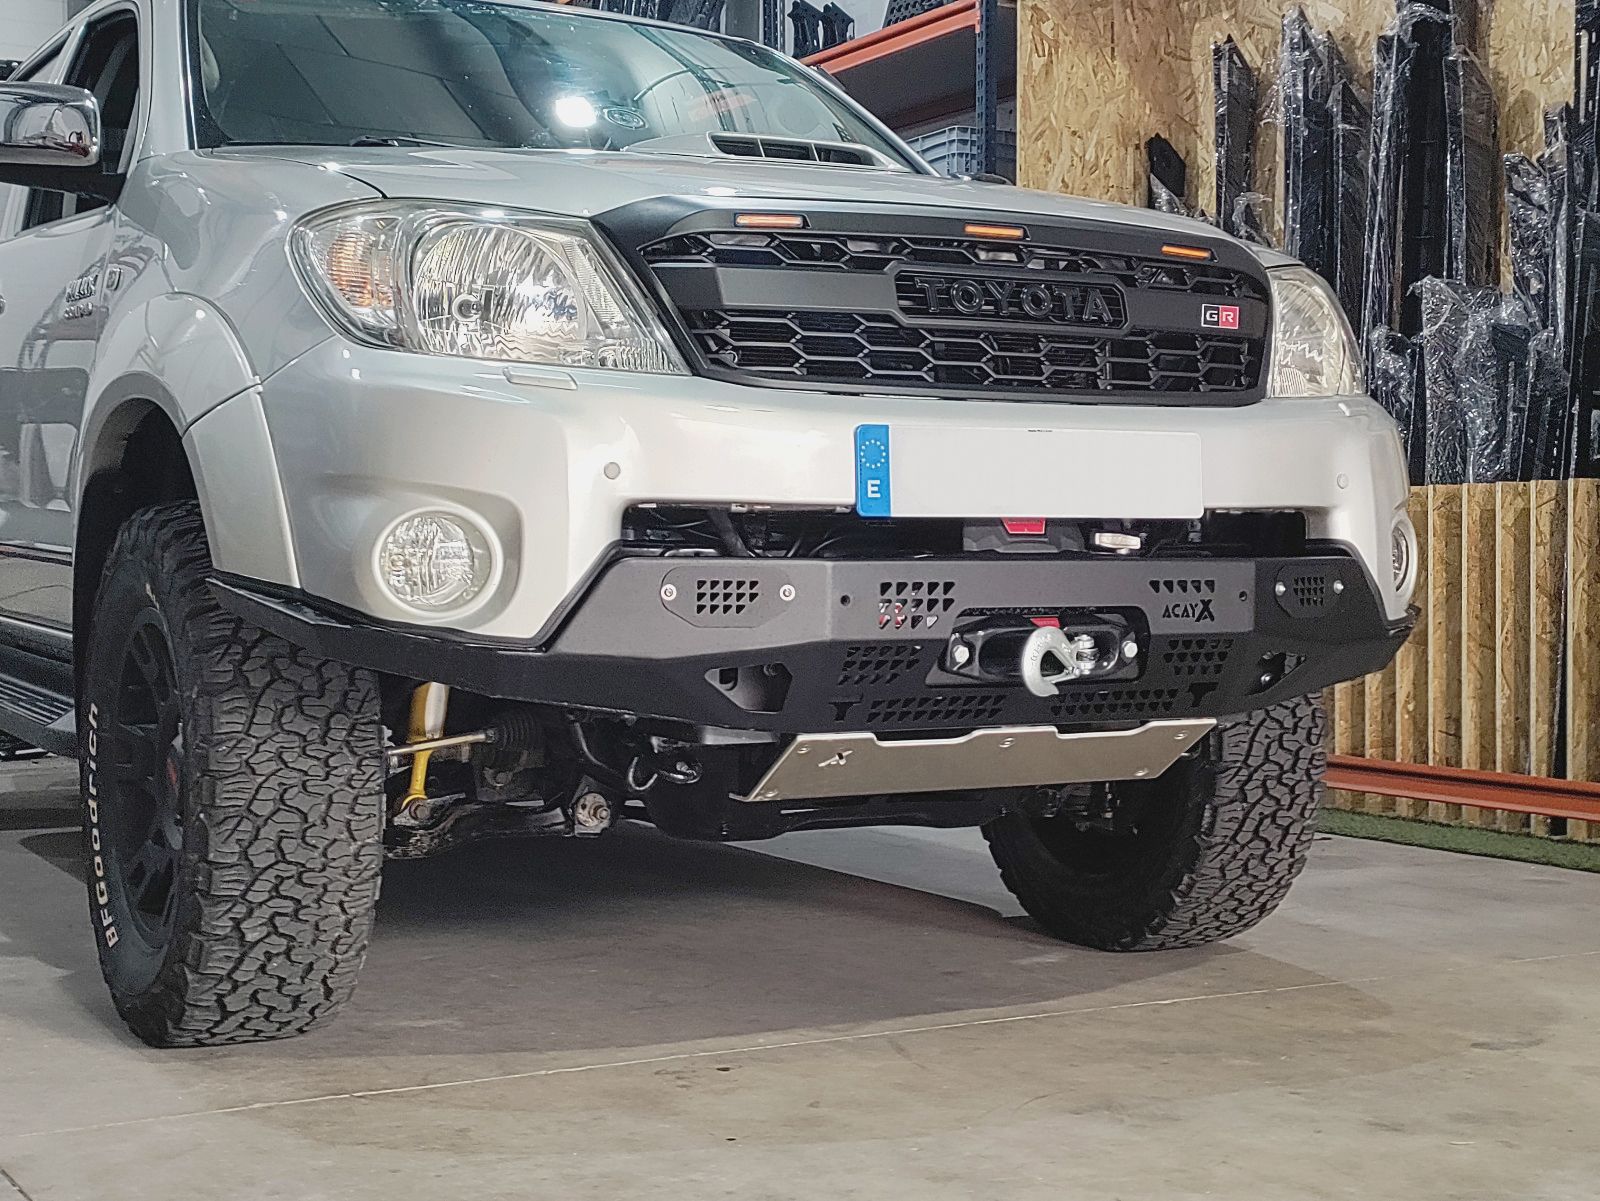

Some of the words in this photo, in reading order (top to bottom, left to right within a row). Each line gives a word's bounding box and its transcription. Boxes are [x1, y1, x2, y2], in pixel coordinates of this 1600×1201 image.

[914, 277, 1114, 324] TOYOTA
[1204, 309, 1236, 325] GR
[867, 479, 881, 498] E
[88, 702, 119, 948] BFGoodrich
